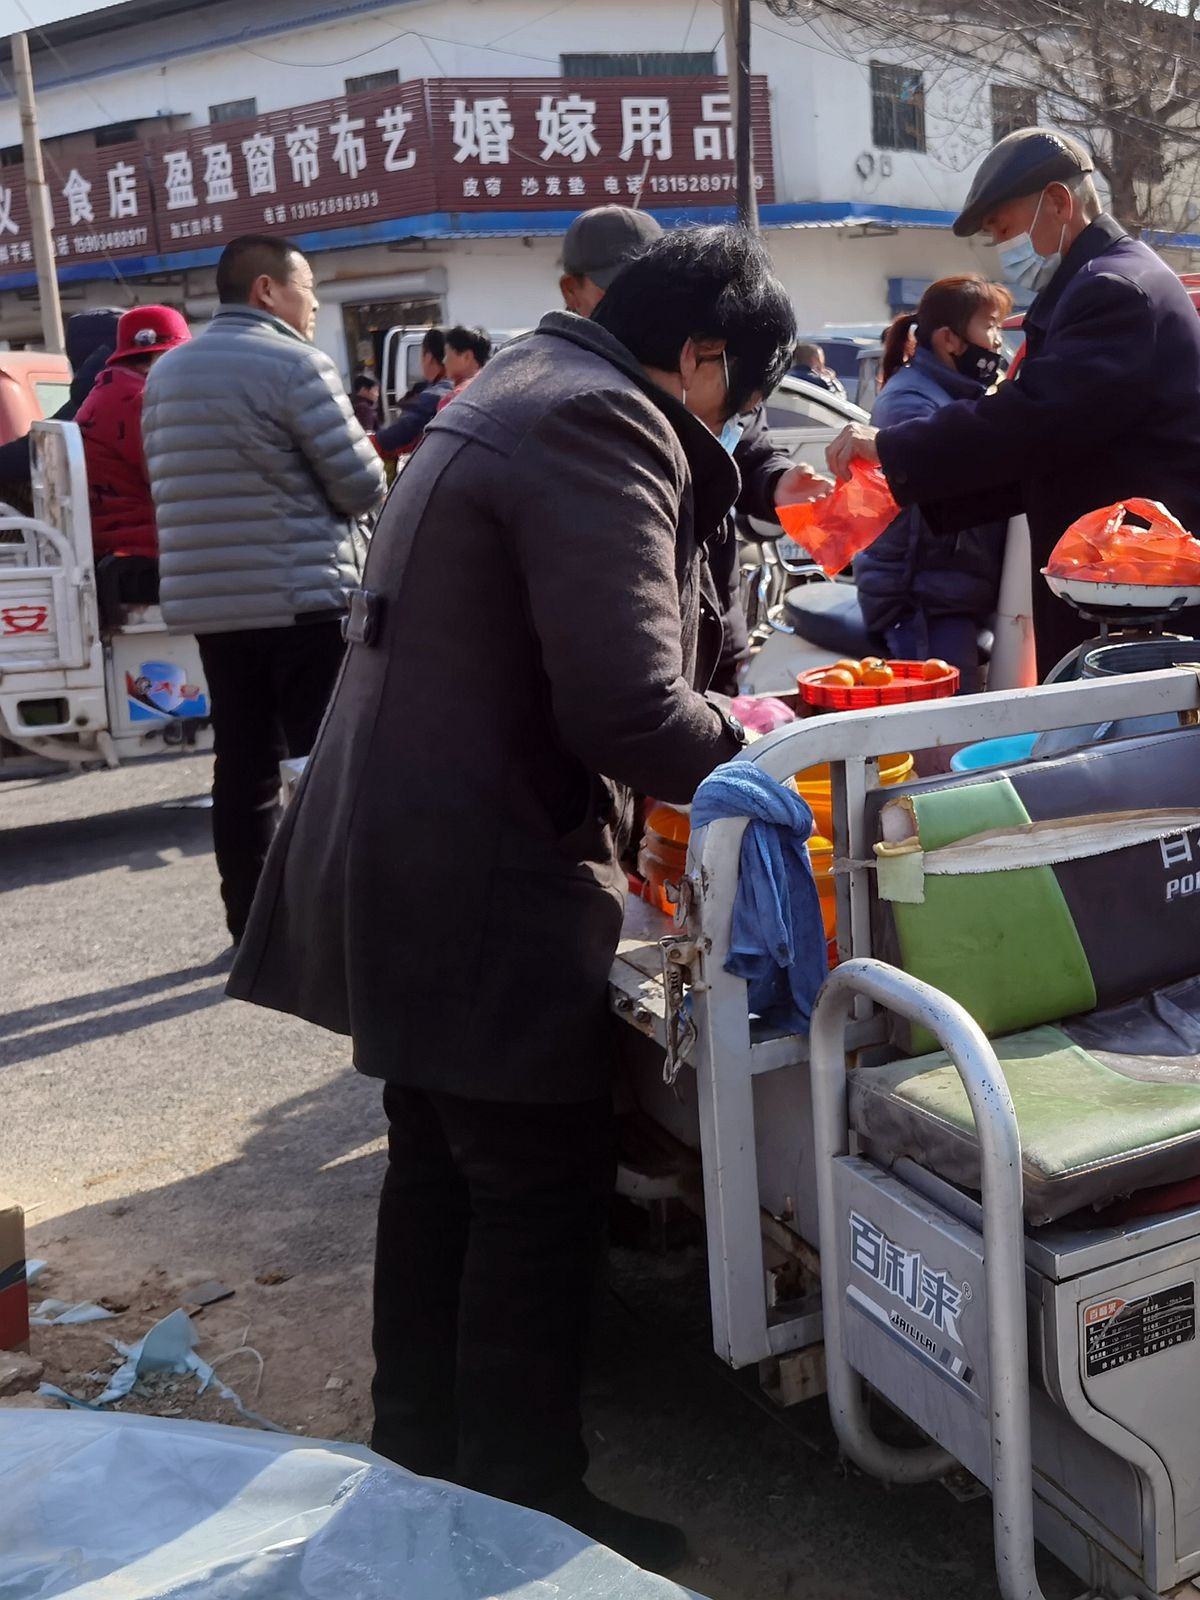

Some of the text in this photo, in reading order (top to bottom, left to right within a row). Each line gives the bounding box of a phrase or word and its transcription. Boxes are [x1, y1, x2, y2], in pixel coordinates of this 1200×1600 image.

[163, 106, 417, 210] 盈盈窗帘布艺
[449, 93, 738, 164] 婚嫁用品
[463, 174, 764, 197] 皮帘 沙发垫 电话 131528979
[849, 1211, 964, 1347] 百利来
[889, 1311, 936, 1353] BAILILAI
